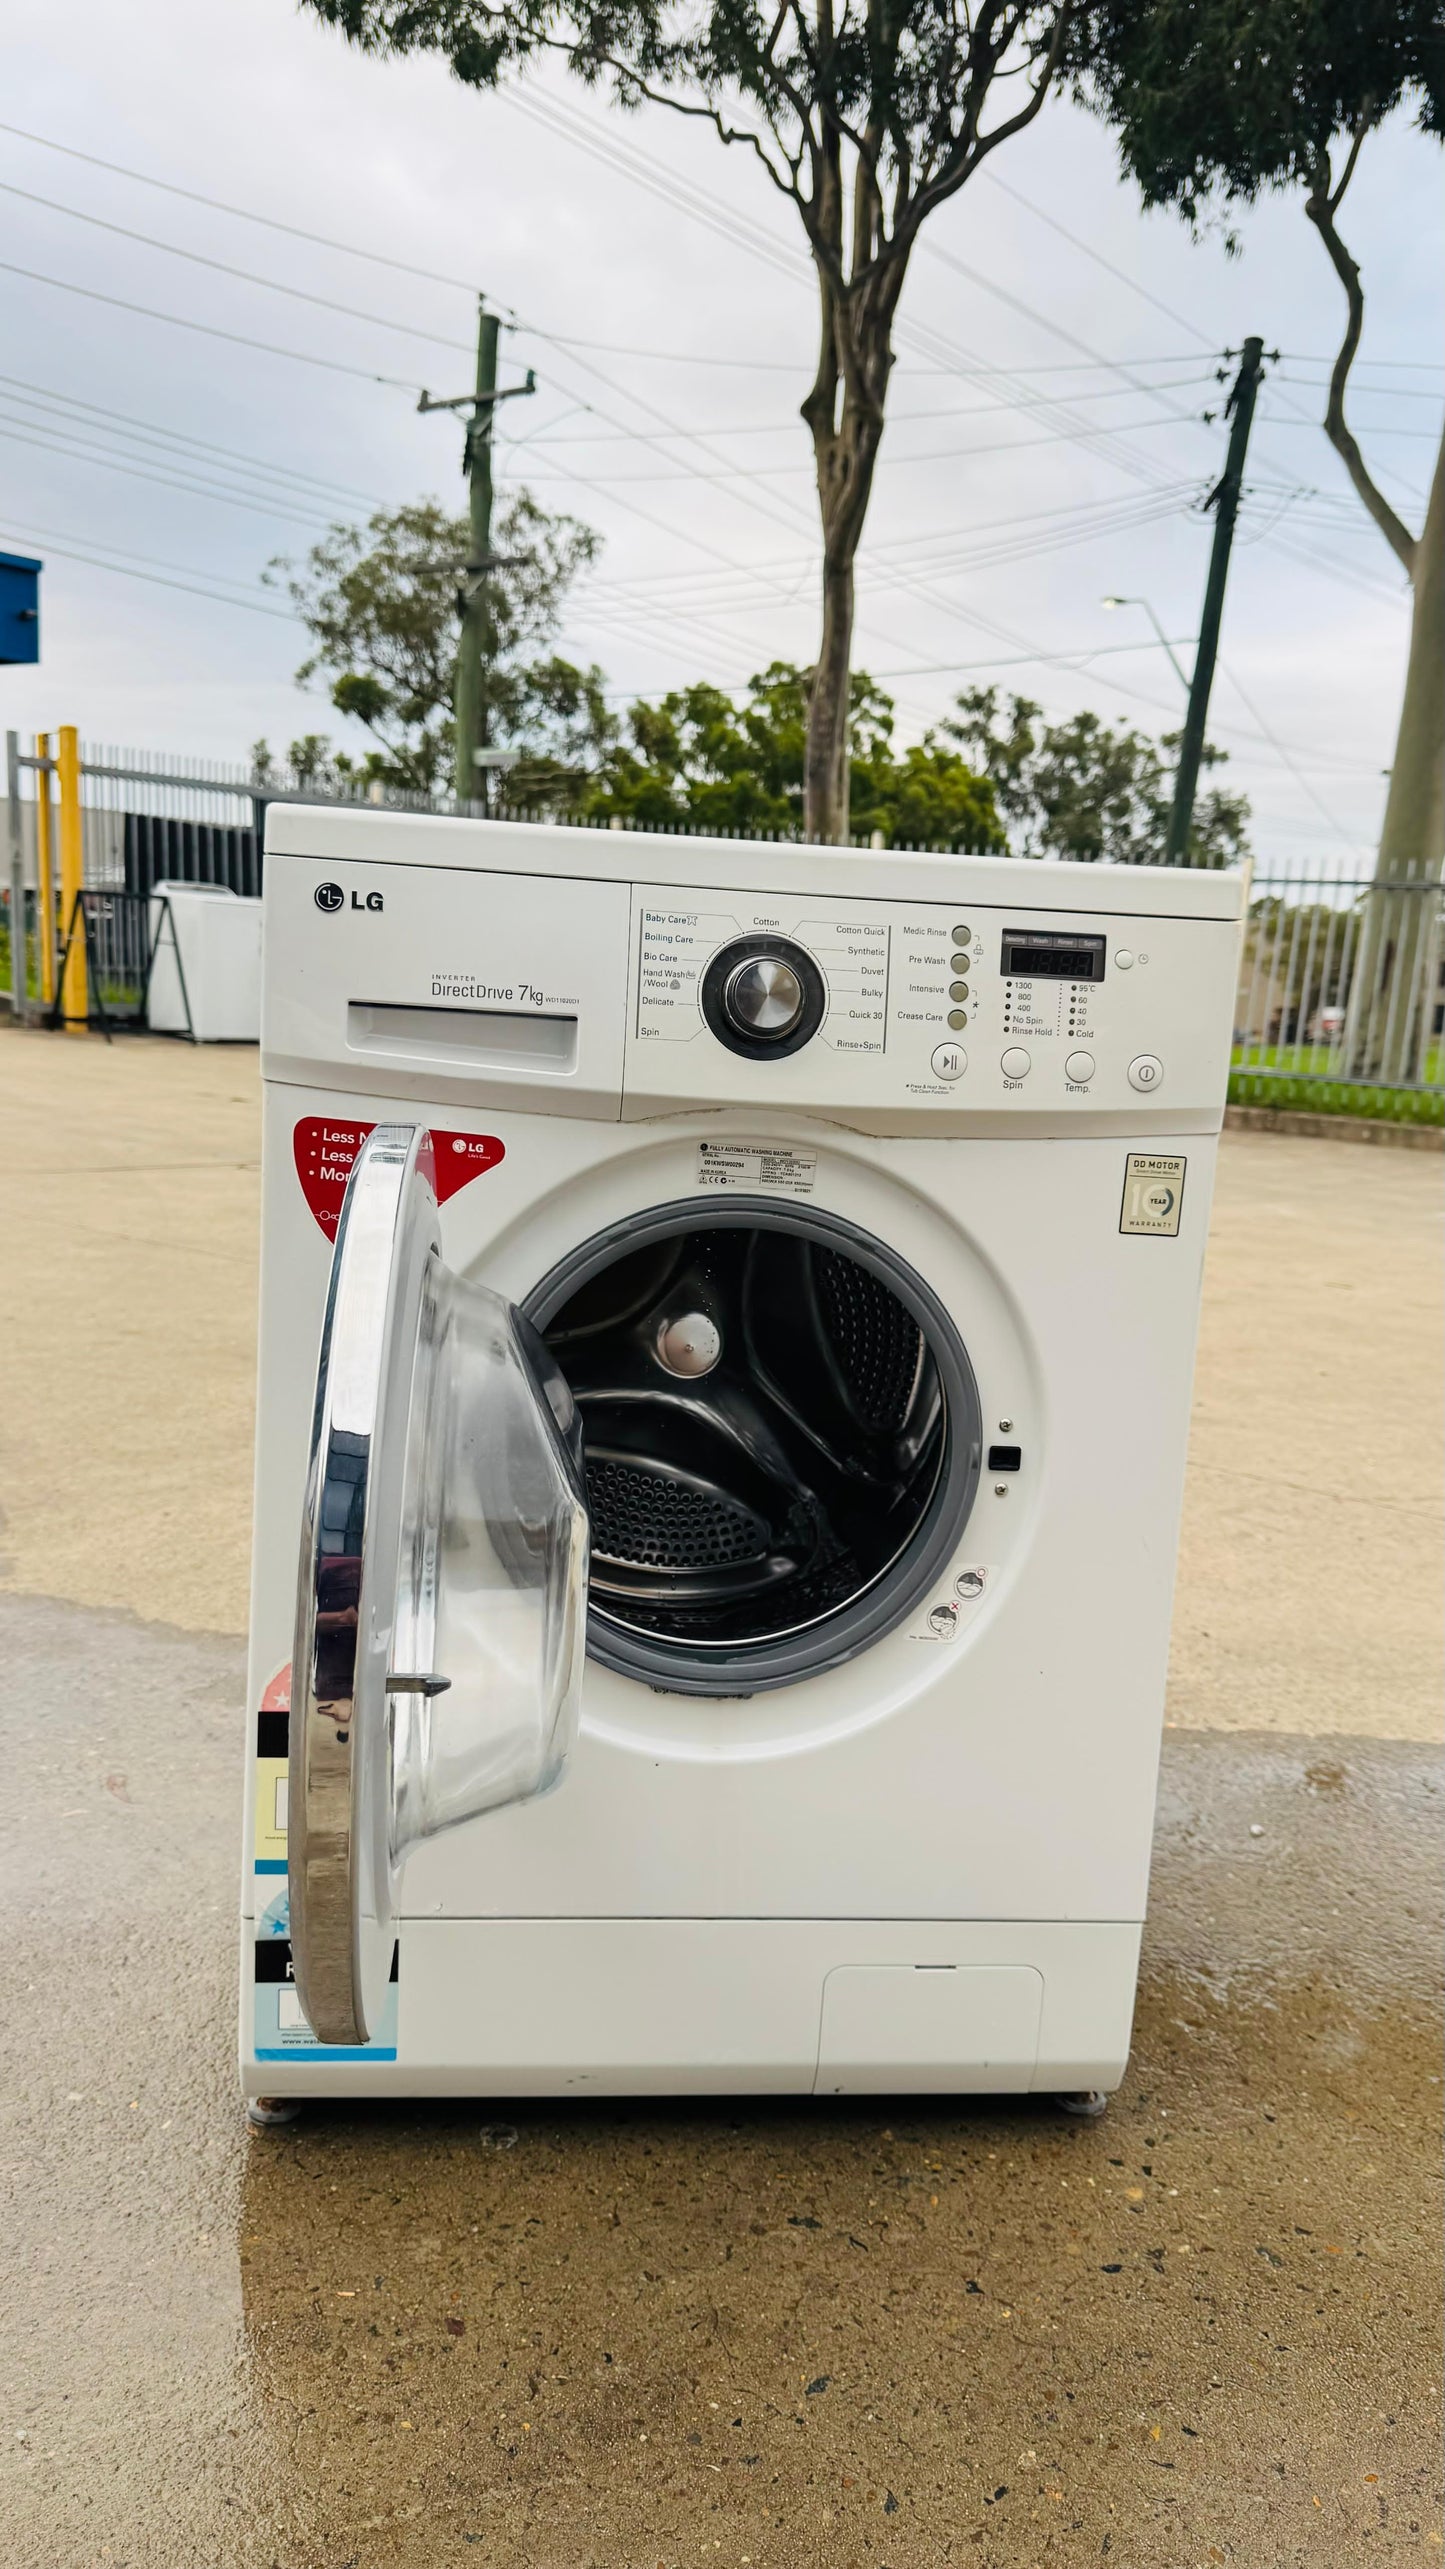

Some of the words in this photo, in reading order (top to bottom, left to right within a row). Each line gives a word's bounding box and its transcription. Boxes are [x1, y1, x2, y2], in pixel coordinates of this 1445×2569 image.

[351, 890, 384, 911] LG
[645, 913, 666, 924] Baby
[668, 915, 687, 925] Care
[753, 917, 780, 926] Cotton
[836, 926, 861, 935] Cotton
[863, 927, 885, 936] Quick
[903, 926, 925, 935] Medic
[927, 928, 947, 937] Rinse
[644, 932, 673, 944] Boiling
[675, 934, 694, 943] Care
[847, 946, 885, 956] Synthetic
[643, 952, 658, 962] Bio
[659, 953, 678, 962] Care
[908, 955, 922, 964] Pre
[923, 956, 946, 965] Wash
[643, 969, 665, 978] Hand
[665, 970, 686, 979] Wash
[861, 967, 884, 975] Duvet
[431, 973, 476, 982] INVERTER
[643, 979, 669, 988] /Wool
[1015, 981, 1032, 990] 1300
[861, 988, 883, 998] Bulky
[909, 984, 945, 994] Intensive
[517, 984, 544, 1006] 7kg
[1017, 993, 1031, 1001] 800
[642, 997, 674, 1006] Delicate
[1017, 1004, 1031, 1012] 400
[849, 1010, 871, 1019] Quick
[873, 1011, 883, 1020] 30
[897, 1011, 924, 1021] Crease
[925, 1012, 943, 1021] Care
[1012, 1015, 1024, 1023] No
[1026, 1016, 1043, 1025] Spin
[1076, 1018, 1086, 1026] 30
[641, 1027, 660, 1037] Spin
[1012, 1026, 1033, 1035] Rinse
[1034, 1028, 1053, 1036] Hold
[1076, 1030, 1094, 1038] Cold
[837, 1040, 881, 1050] Rinse+Spin
[1002, 1079, 1023, 1091] Spin
[1064, 1082, 1091, 1094] Temp.
[322, 1128, 355, 1144] Less
[468, 1143, 484, 1153] LG
[321, 1147, 353, 1163] Less
[1133, 1160, 1146, 1168] DD
[1148, 1161, 1180, 1170] MOTOR
[320, 1166, 352, 1182] Mor
[1129, 1220, 1172, 1228] WARRANTY
